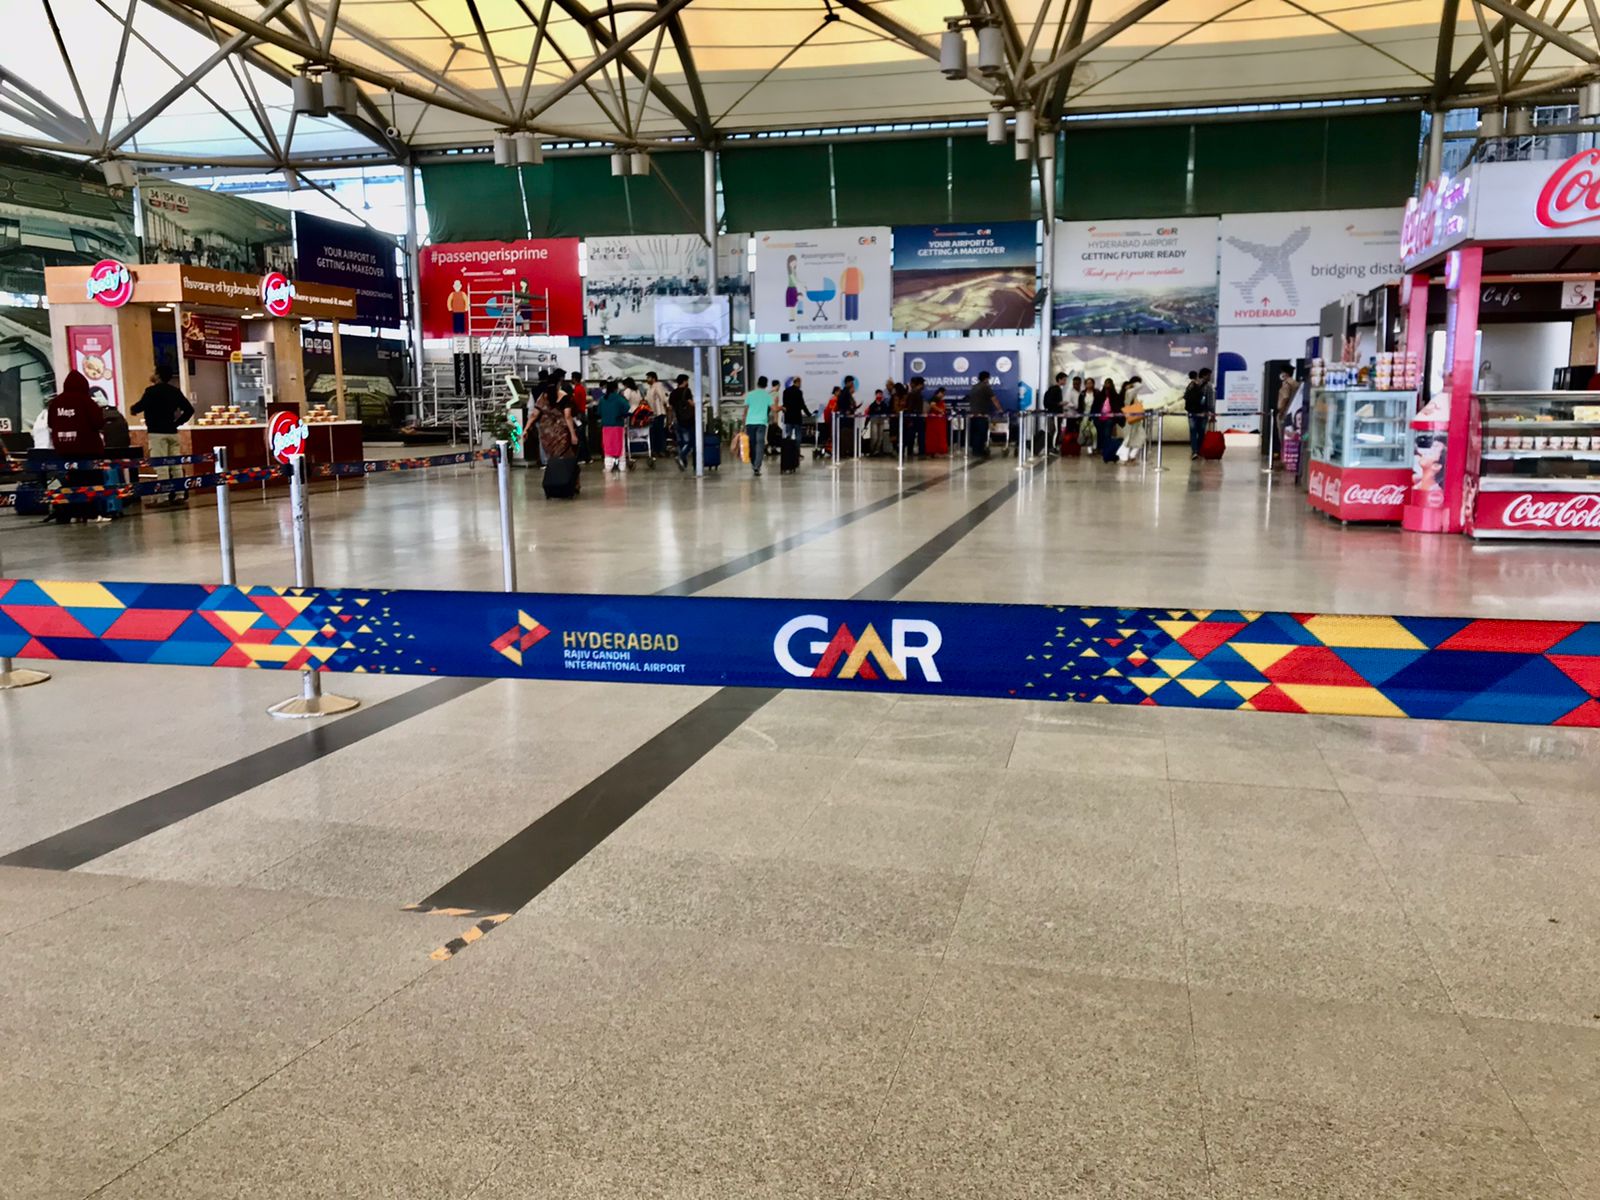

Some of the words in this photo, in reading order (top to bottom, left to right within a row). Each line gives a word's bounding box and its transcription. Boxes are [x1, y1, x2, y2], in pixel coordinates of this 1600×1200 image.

[928, 240, 951, 249] YOUR
[951, 239, 985, 248] AIRPORT
[1141, 238, 1179, 247] AIRPORT
[342, 250, 369, 263] AIRPORT
[431, 246, 548, 266] #passengerisprime
[917, 248, 952, 256] GETTING
[953, 247, 960, 255] A
[960, 246, 1005, 255] MAKEOVER
[1081, 251, 1119, 261] GETTING
[1121, 250, 1156, 259] FUTURE
[1157, 249, 1187, 258] READY
[316, 257, 346, 271] GETTING
[351, 265, 384, 277] MAKEOVER
[1311, 263, 1366, 279] bridging
[1482, 286, 1521, 307] Cafe
[1234, 308, 1297, 318] HYDERABAD
[563, 631, 679, 651] HYDERABAD
[773, 613, 943, 683] GMR
[564, 649, 590, 660] RAJIV
[592, 650, 630, 661] GANDHI
[564, 660, 641, 672] INTERNATIONAL
[643, 662, 686, 673] AIRPORT
